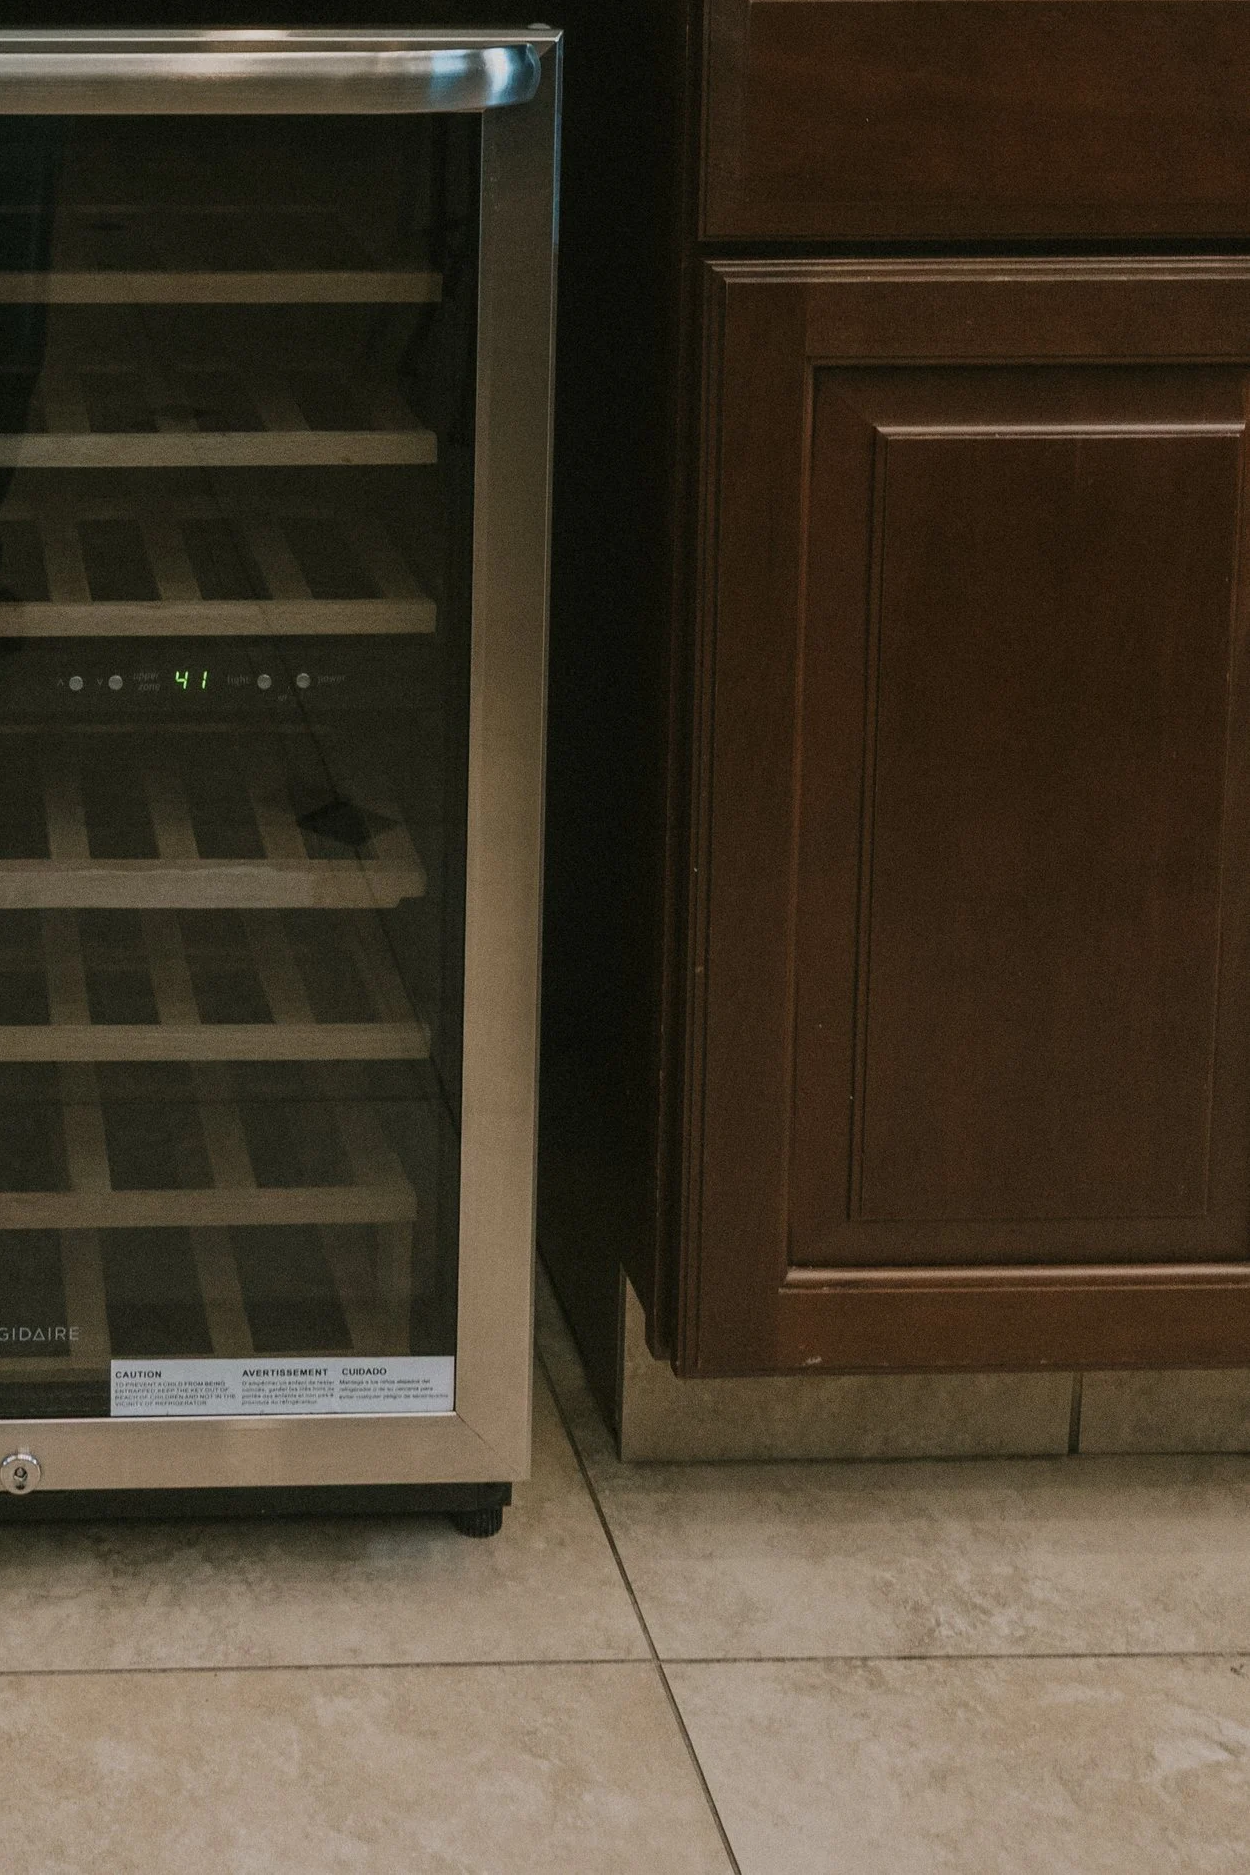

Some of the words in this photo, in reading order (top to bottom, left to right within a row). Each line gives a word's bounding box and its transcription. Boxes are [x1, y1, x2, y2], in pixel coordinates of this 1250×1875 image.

[175, 670, 207, 690] 41
[115, 1371, 162, 1379] CAUTION
[242, 1368, 328, 1377] AVERTISSEMENT
[342, 1367, 387, 1376] CUIDADO
